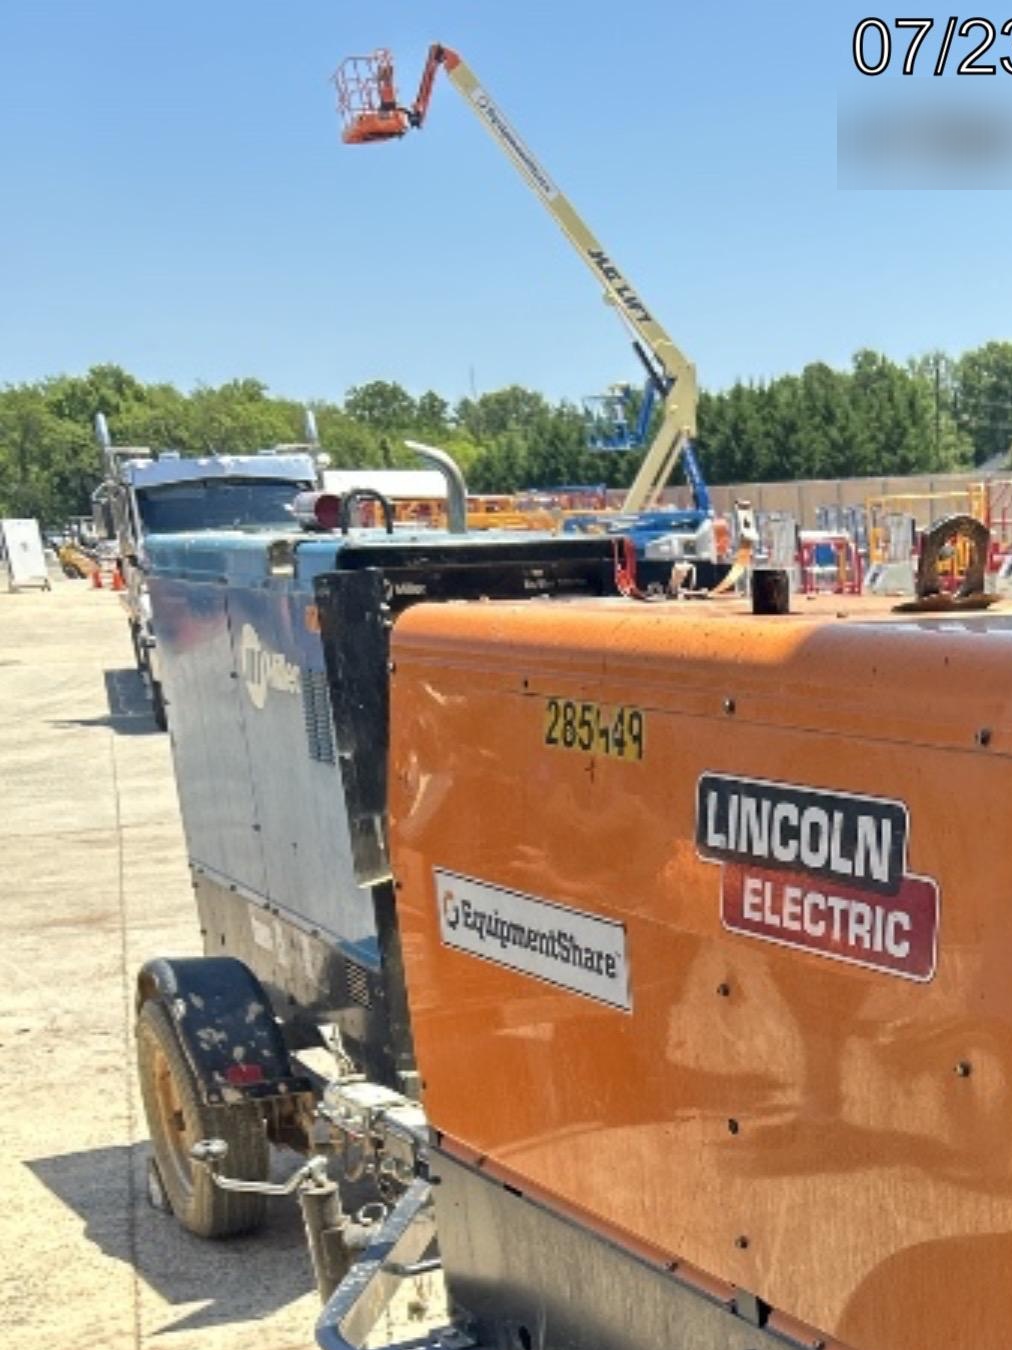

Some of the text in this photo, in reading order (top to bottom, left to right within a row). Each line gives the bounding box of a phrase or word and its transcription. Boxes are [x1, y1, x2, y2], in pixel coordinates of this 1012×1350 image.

[707, 791, 893, 883] LINCOLN
[461, 899, 617, 979] EquipmentShare
[742, 876, 912, 959] ELECTRIC
